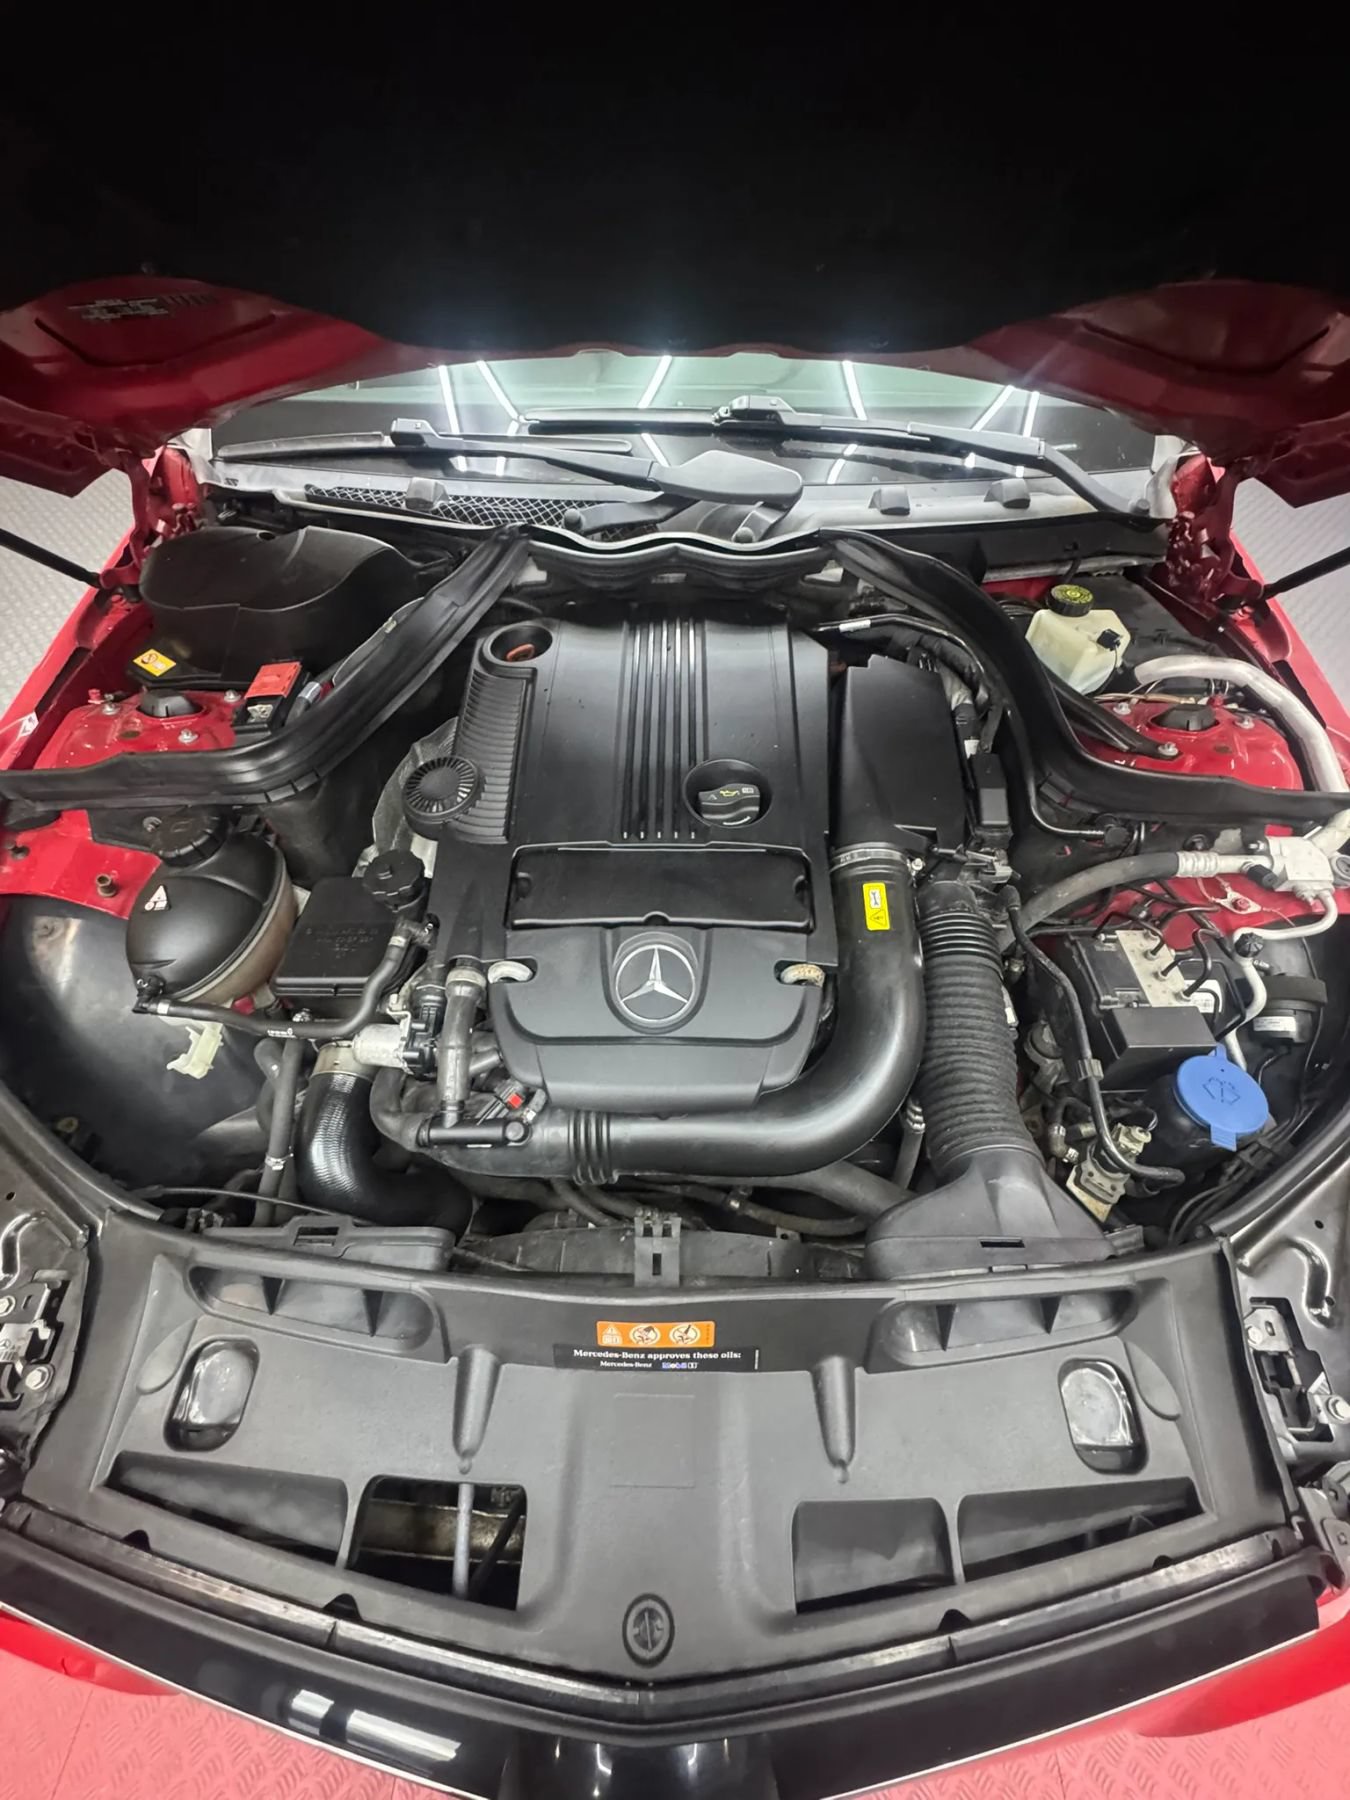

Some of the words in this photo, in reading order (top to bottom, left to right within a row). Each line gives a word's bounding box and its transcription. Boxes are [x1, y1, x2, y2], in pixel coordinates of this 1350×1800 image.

[573, 1349, 645, 1359] Mercedes-Benz
[647, 1352, 691, 1360] approves
[693, 1351, 718, 1359] these
[720, 1351, 742, 1359] oils:
[600, 1360, 652, 1368] Mercedes-Benz
